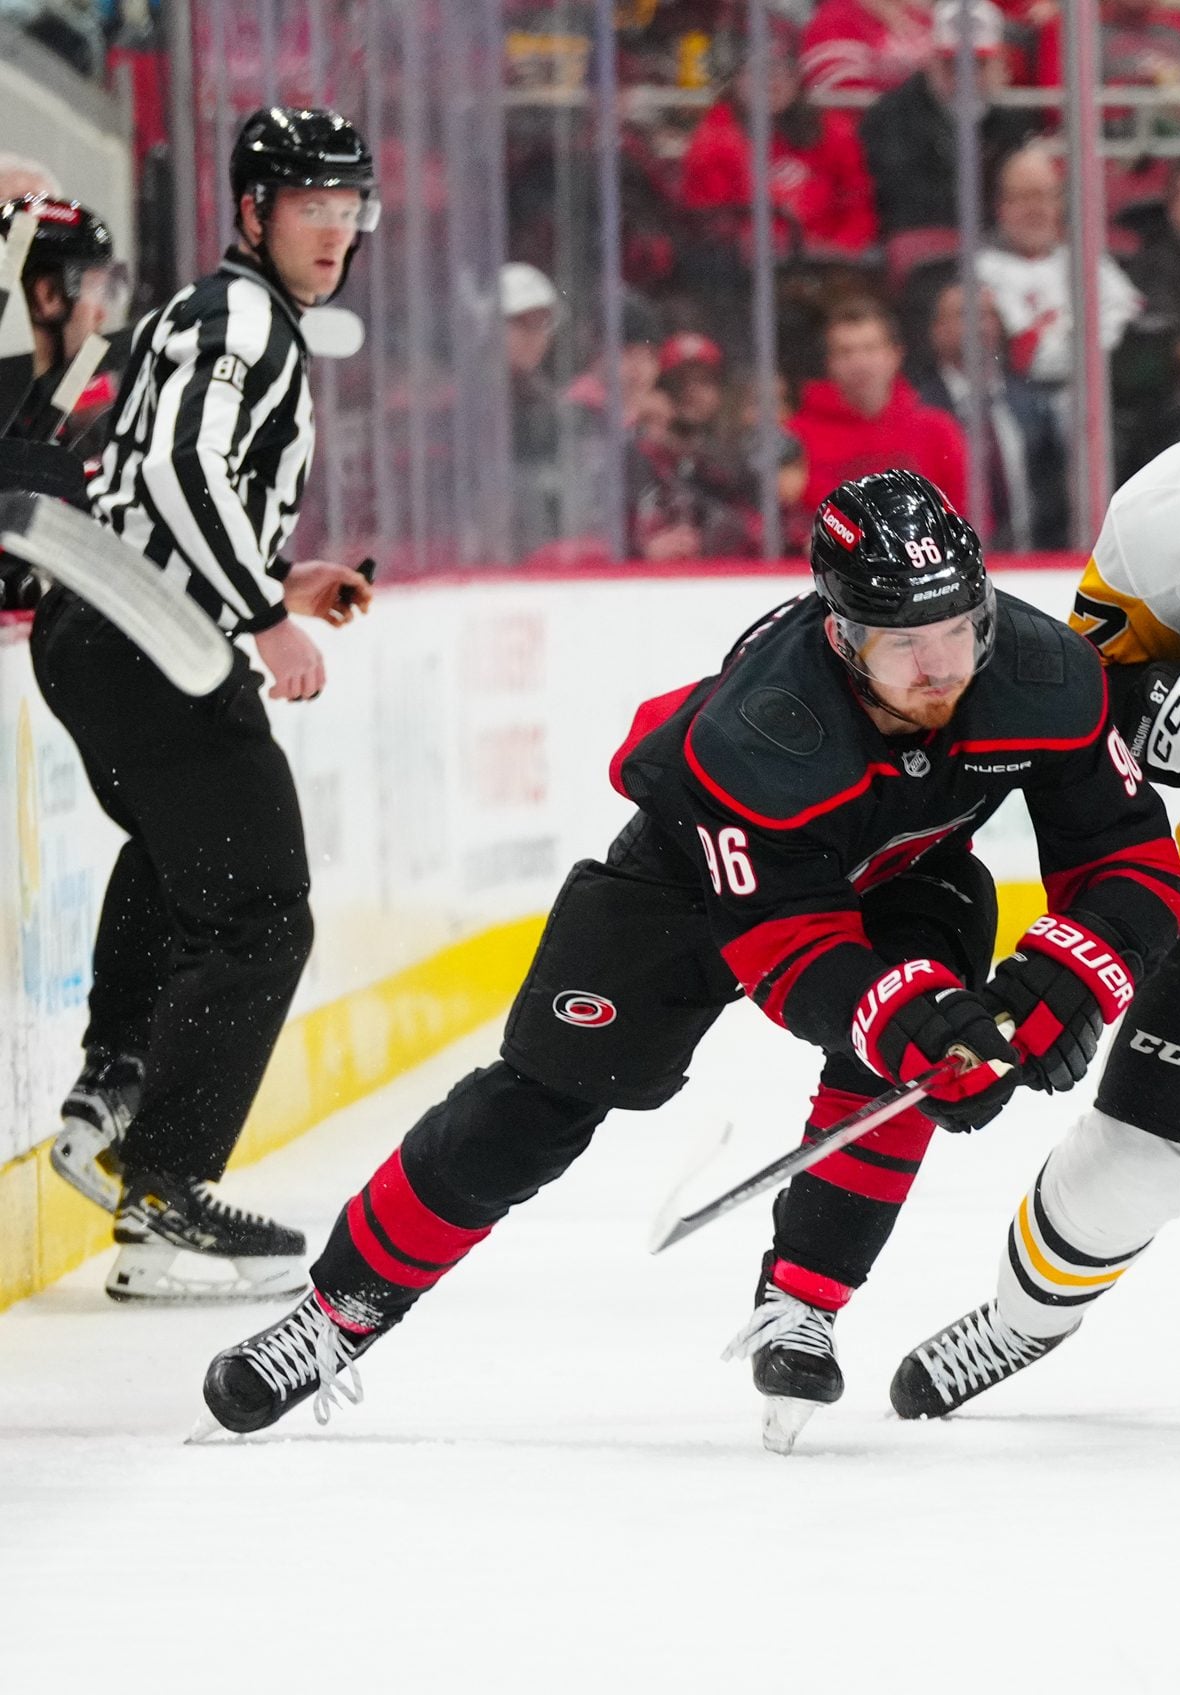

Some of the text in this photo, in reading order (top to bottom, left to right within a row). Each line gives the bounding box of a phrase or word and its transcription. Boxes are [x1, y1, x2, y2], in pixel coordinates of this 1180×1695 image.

[822, 507, 856, 545] Lenovo
[904, 536, 942, 569] 96
[912, 582, 961, 602] BAUER
[1150, 679, 1170, 705] 87
[1131, 715, 1153, 761] ENGUINS
[964, 759, 1033, 774] NUCOR
[696, 825, 757, 896] 96
[1026, 916, 1135, 1009] BAUER
[852, 958, 935, 1078] AUER
